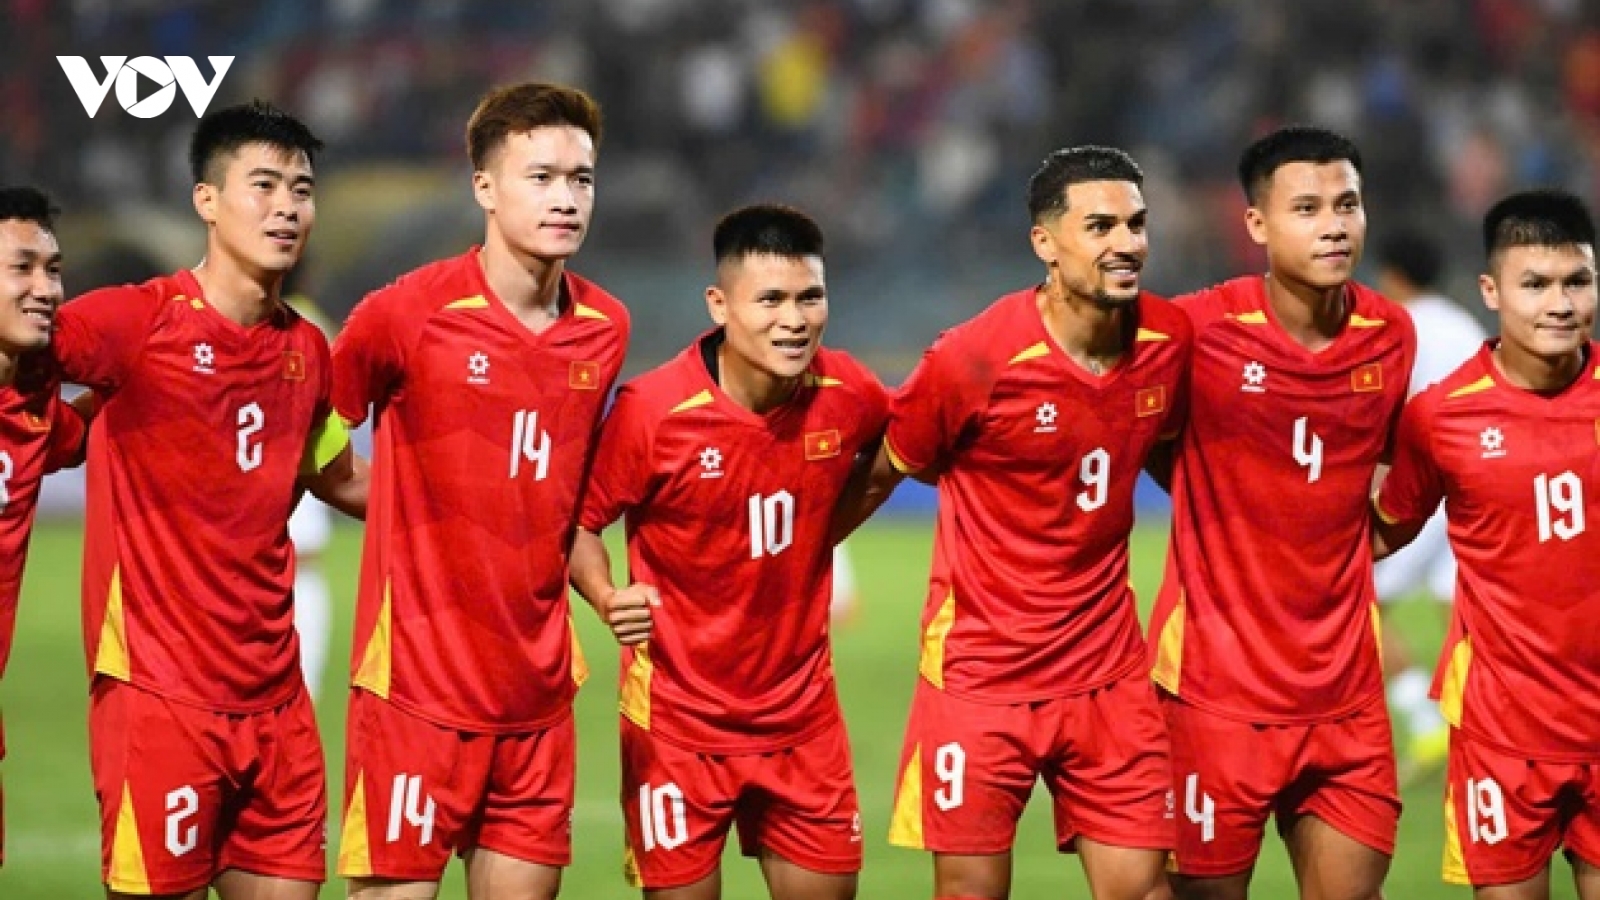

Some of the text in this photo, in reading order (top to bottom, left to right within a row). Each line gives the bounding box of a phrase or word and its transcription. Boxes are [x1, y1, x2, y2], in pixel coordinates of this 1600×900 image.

[237, 402, 263, 471] 2
[509, 410, 551, 480] 14
[1292, 416, 1323, 482] 4
[1076, 447, 1109, 511] 9
[1534, 470, 1585, 542] 19
[748, 489, 794, 558] 10
[387, 774, 436, 846] 14
[934, 741, 966, 810] 9
[1184, 774, 1215, 842] 4
[164, 785, 198, 857] 2
[639, 781, 688, 851] 10
[1466, 777, 1508, 845] 19
